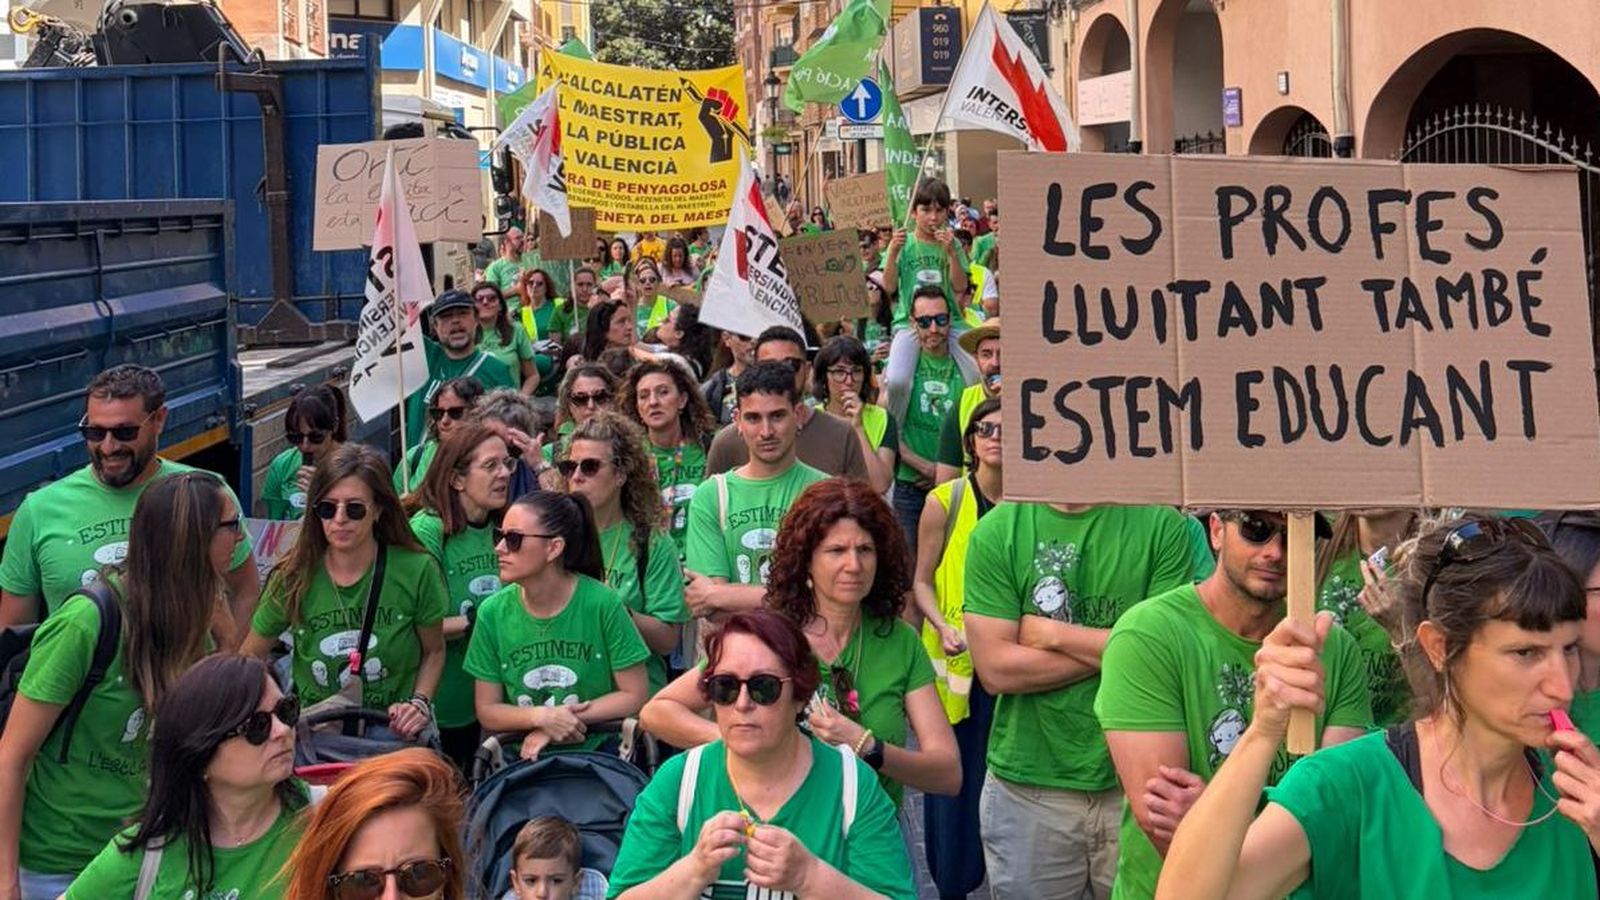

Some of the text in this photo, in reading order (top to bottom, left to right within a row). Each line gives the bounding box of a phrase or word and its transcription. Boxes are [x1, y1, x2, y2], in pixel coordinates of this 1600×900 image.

[932, 23, 949, 33] 960
[932, 37, 950, 46] 019
[932, 51, 950, 60] 019
[573, 99, 684, 130] MAESTRAT,
[966, 85, 1029, 132] INTERS
[566, 122, 590, 142] LA
[596, 129, 686, 151] PÚBLICA
[574, 149, 679, 175] VALENCIÀ
[567, 172, 587, 187] RA
[591, 177, 612, 191] DE
[616, 178, 728, 196] PENYAGOLOSA
[594, 207, 732, 225] ENETA DEL MAEST
[1043, 180, 1505, 265] LES PROFES
[1042, 247, 1552, 345] LLUITANT TAMBÉ
[1021, 360, 1554, 464] ESTEM EDUCANT
[310, 606, 395, 633] ESTIMM
